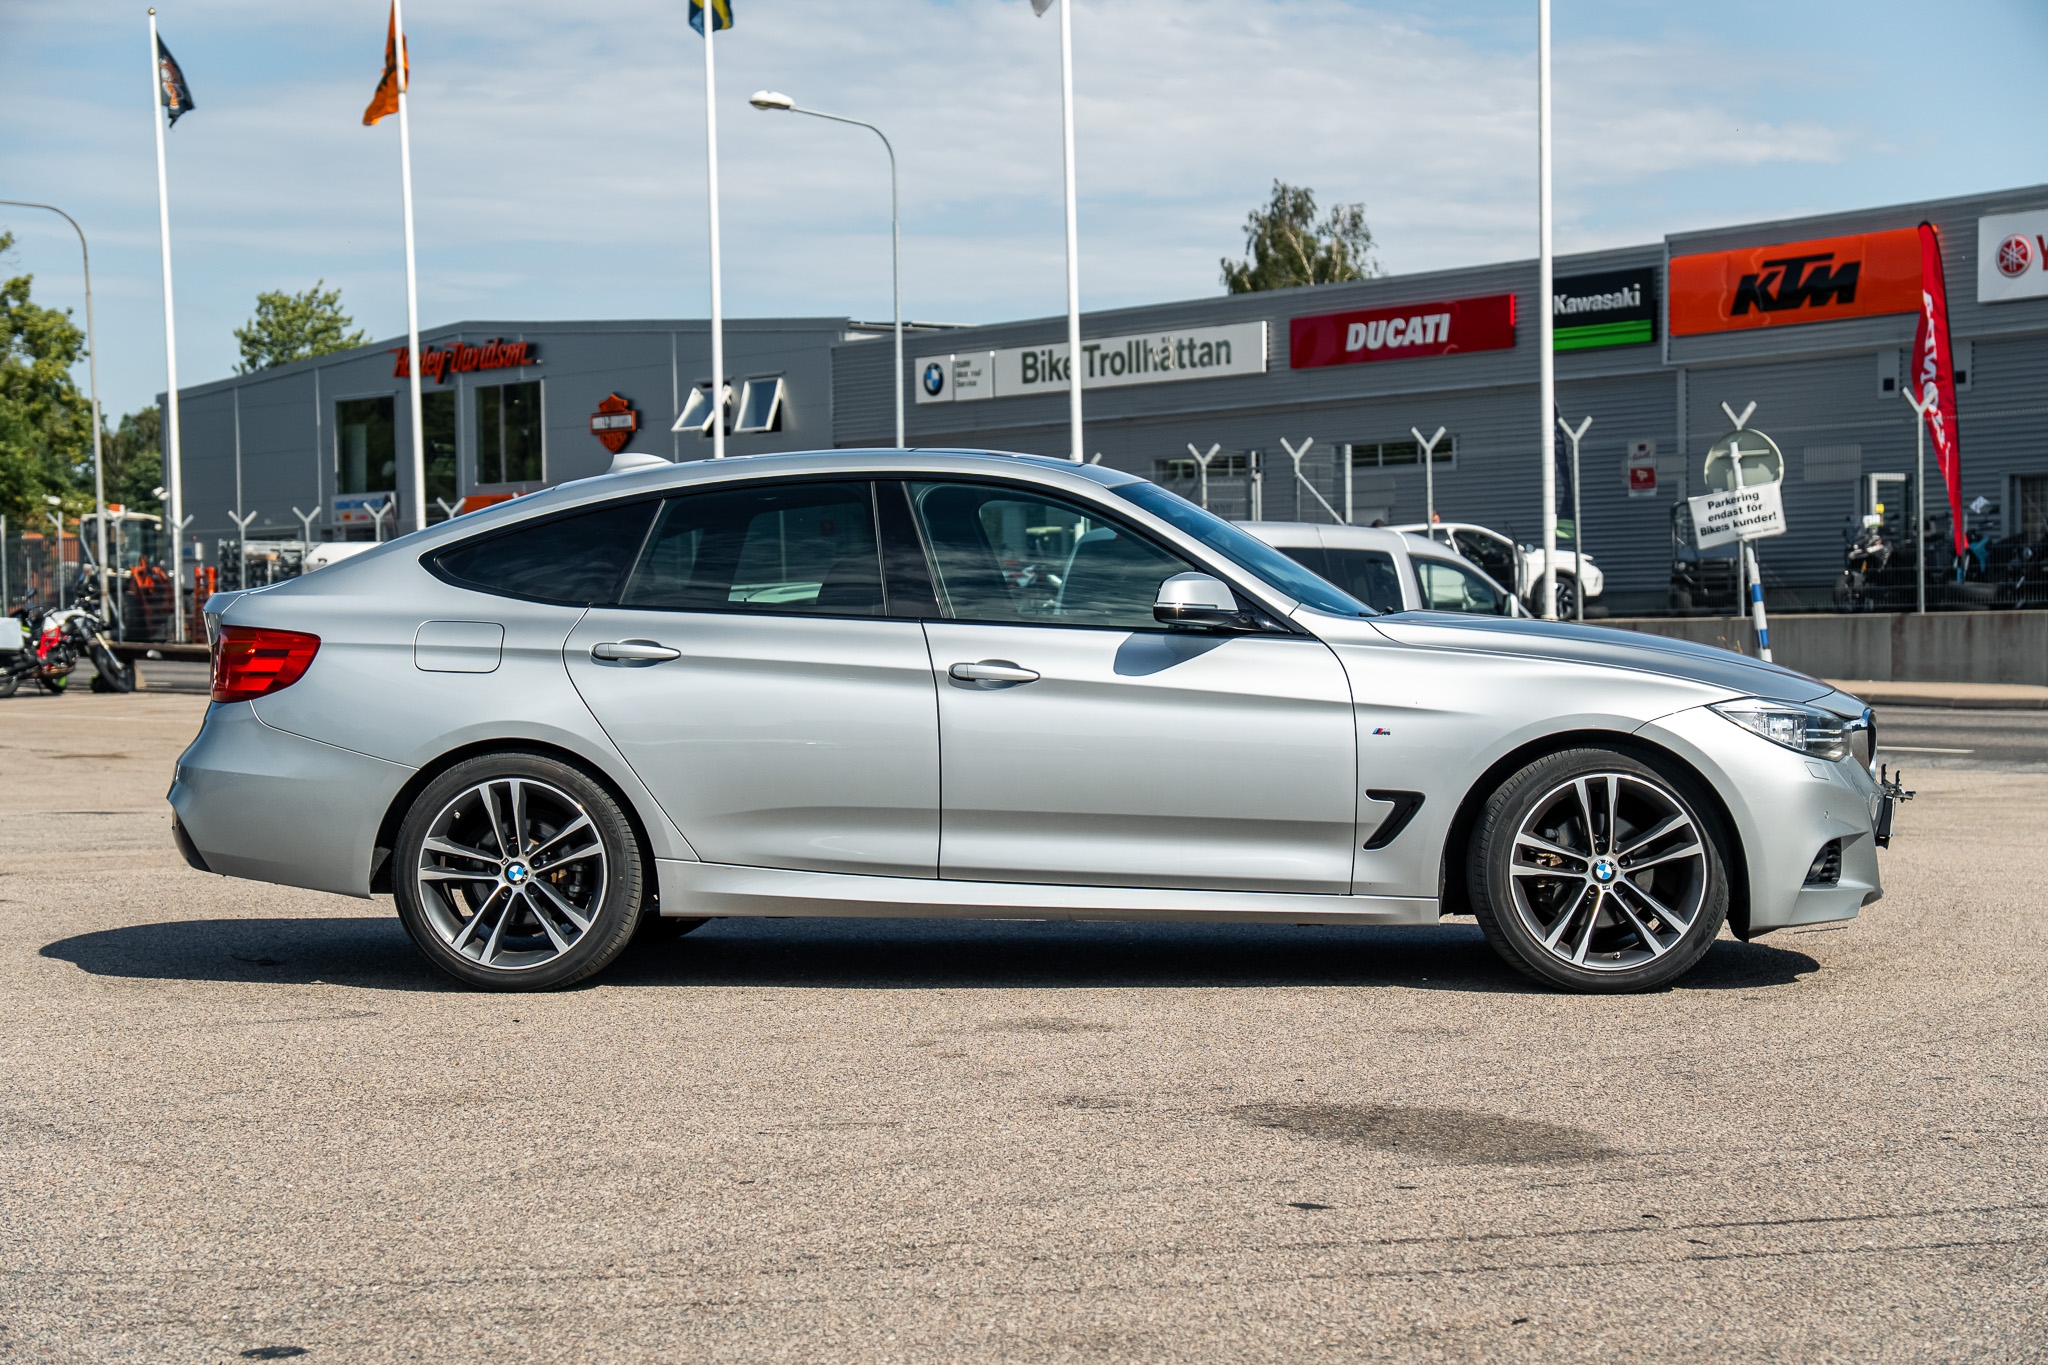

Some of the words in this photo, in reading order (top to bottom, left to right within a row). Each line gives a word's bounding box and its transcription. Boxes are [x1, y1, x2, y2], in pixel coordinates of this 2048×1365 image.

[1553, 283, 1641, 315] Kawasaki
[1730, 252, 1861, 316] KTM
[1345, 313, 1451, 352] DUCATI
[388, 338, 533, 385] Hley-Davidson
[1082, 336, 1232, 378] Trollhättan
[1707, 492, 1760, 510] Parkering
[1708, 507, 1743, 522] endast
[1700, 523, 1730, 537] Bike:s
[1732, 511, 1777, 528] kunder!
